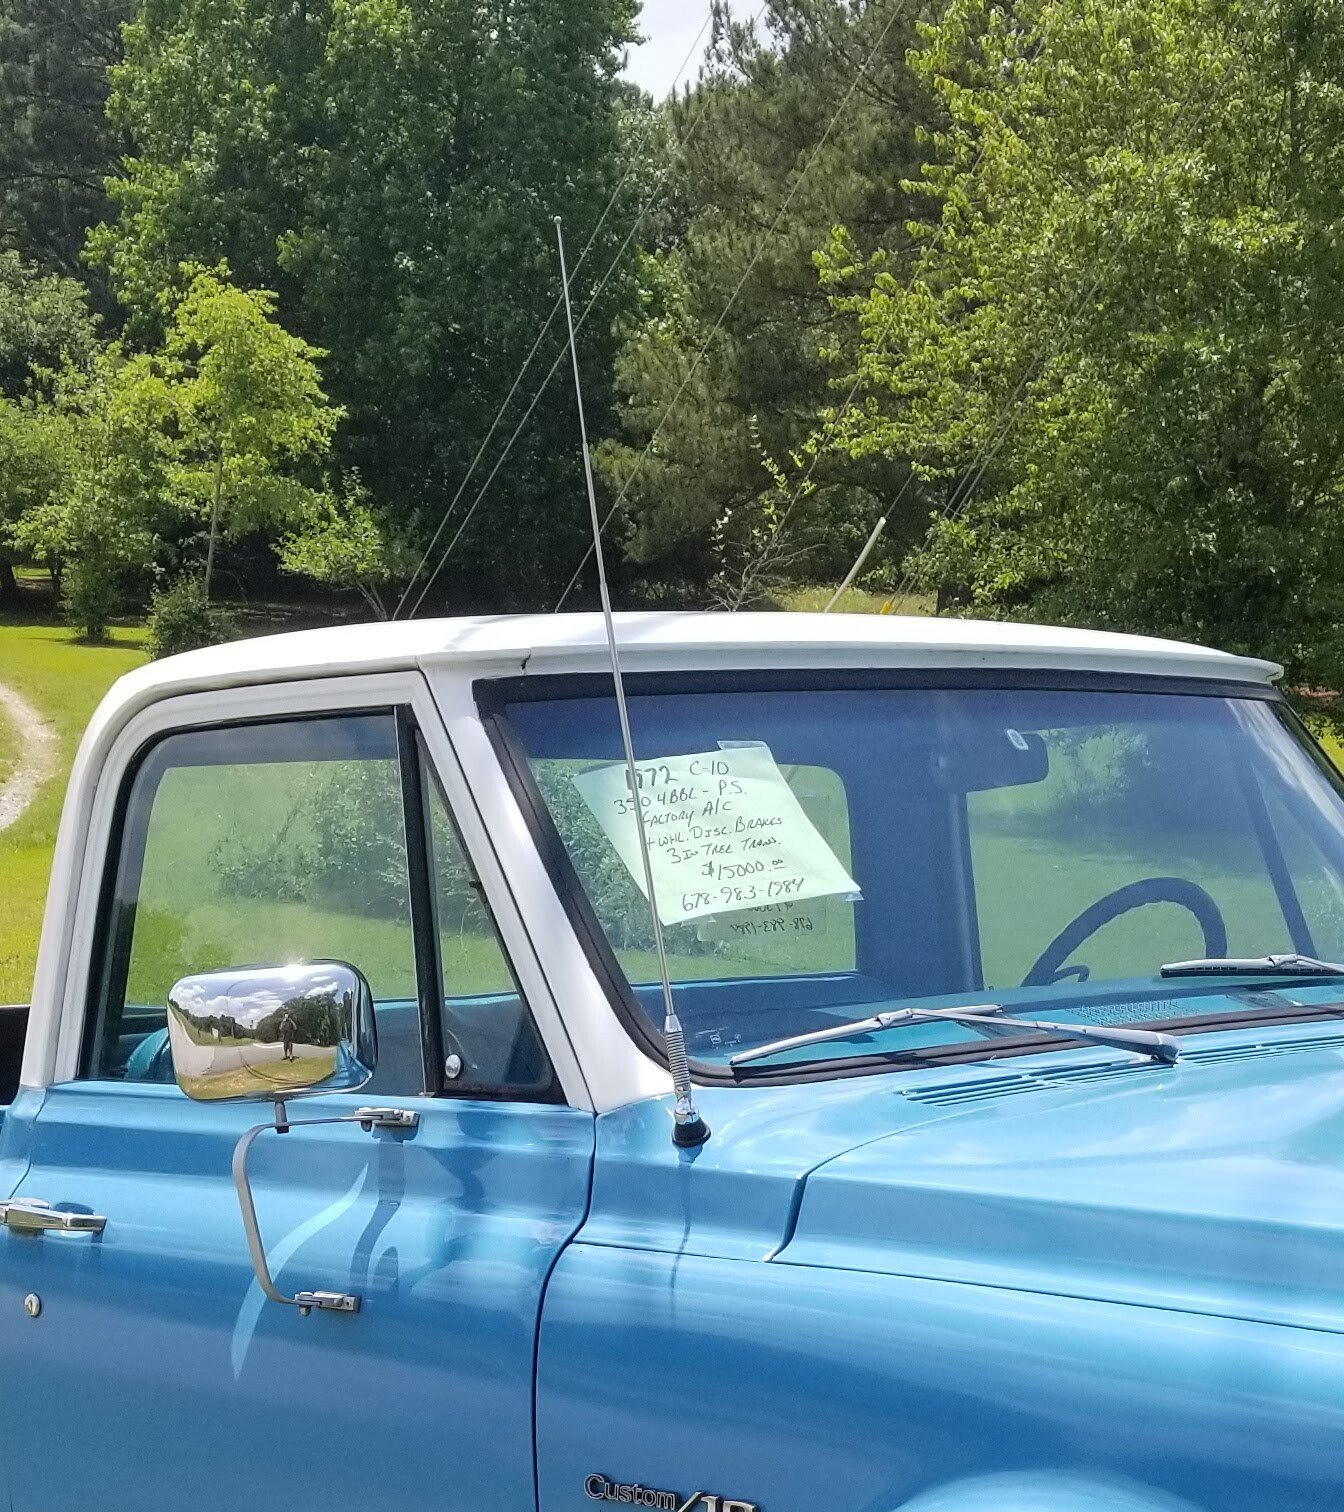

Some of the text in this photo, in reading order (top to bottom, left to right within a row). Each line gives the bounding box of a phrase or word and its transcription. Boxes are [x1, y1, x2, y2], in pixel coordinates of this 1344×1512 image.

[689, 760, 729, 776] C-10
[657, 787, 697, 805] 4BBL
[718, 779, 748, 796] P.S.
[642, 798, 732, 828] FACTORY A/C
[735, 815, 783, 833] BRAKES
[700, 843, 733, 855] TREE
